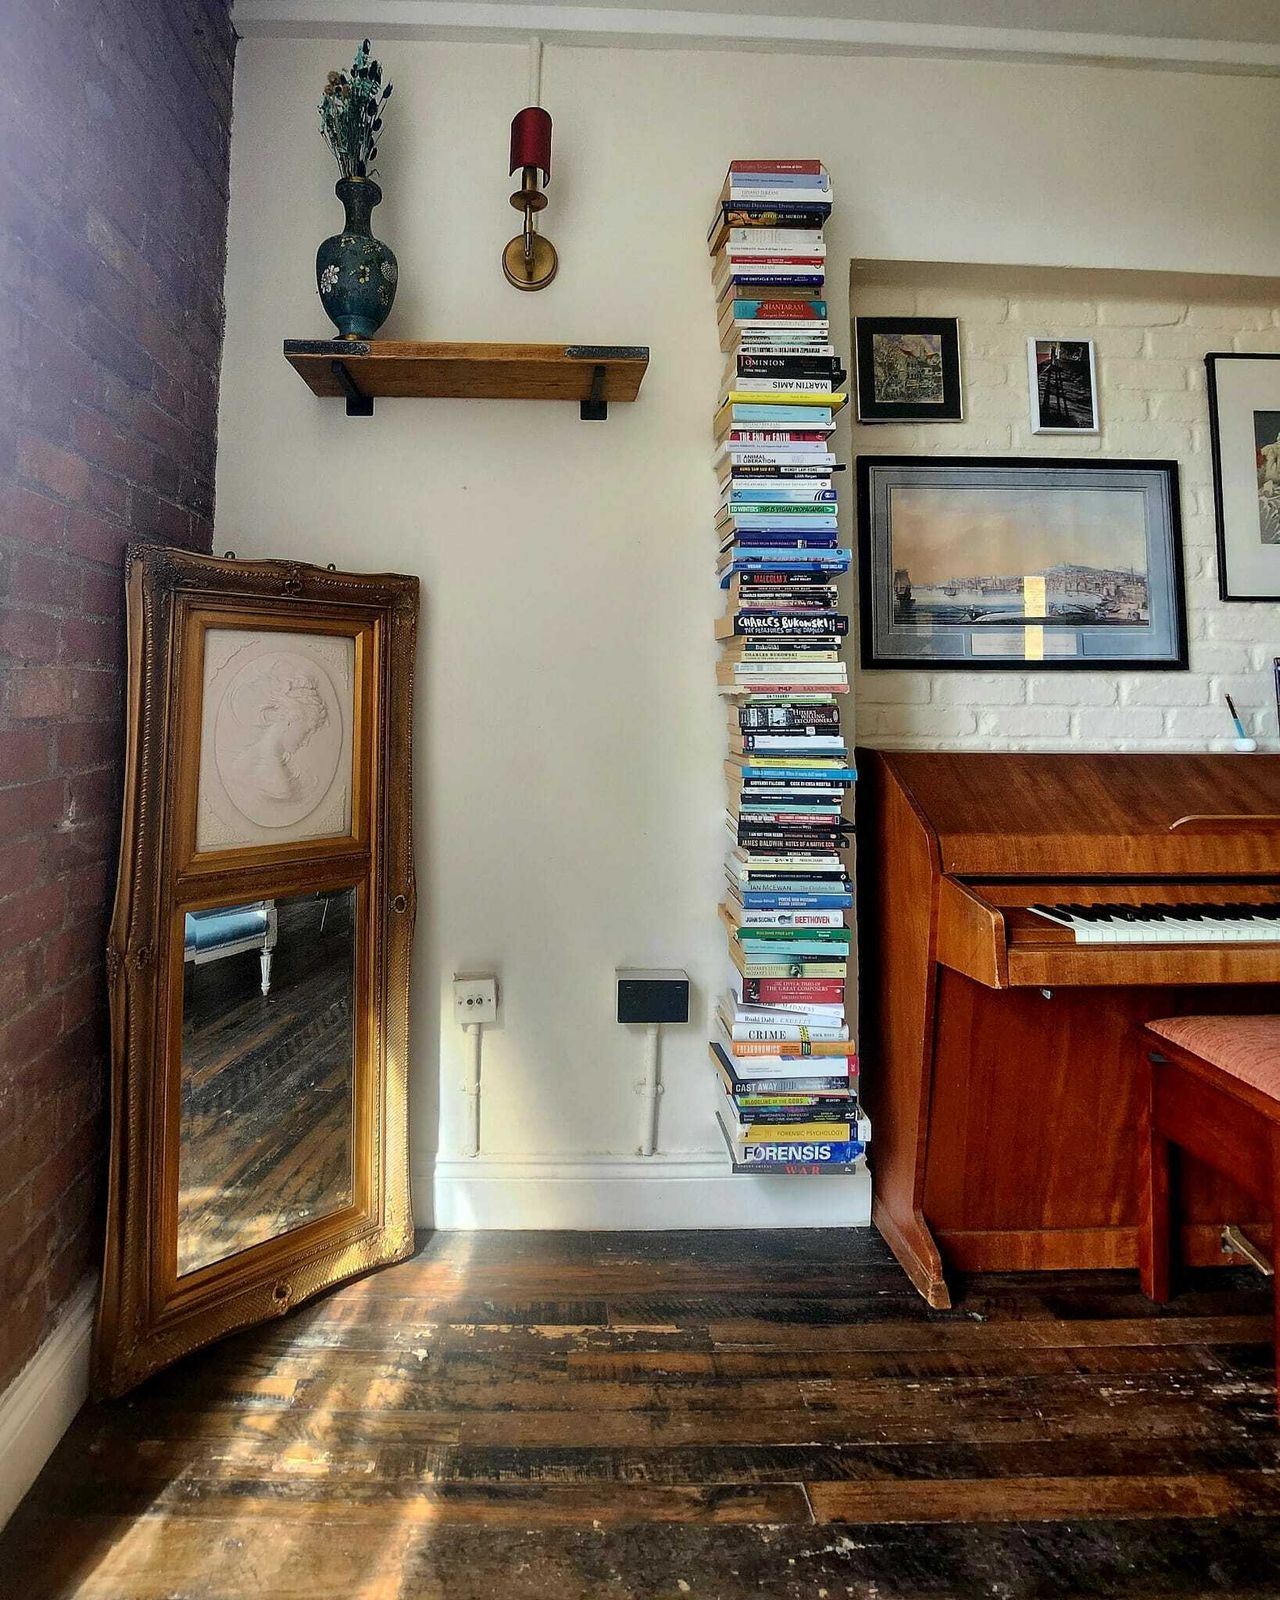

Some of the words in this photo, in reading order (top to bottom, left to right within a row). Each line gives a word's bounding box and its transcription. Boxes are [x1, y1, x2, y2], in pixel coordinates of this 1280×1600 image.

[741, 356, 785, 368] DOMINION
[796, 382, 828, 390] MARTIN
[738, 617, 780, 628] CHARLES
[782, 617, 828, 628] BUKOWSKI
[748, 1030, 786, 1040] CRIME
[736, 1084, 756, 1092] CAST
[758, 1081, 778, 1091] AWAY
[744, 1146, 831, 1161] FORENSIS
[785, 1165, 820, 1174] WAR
